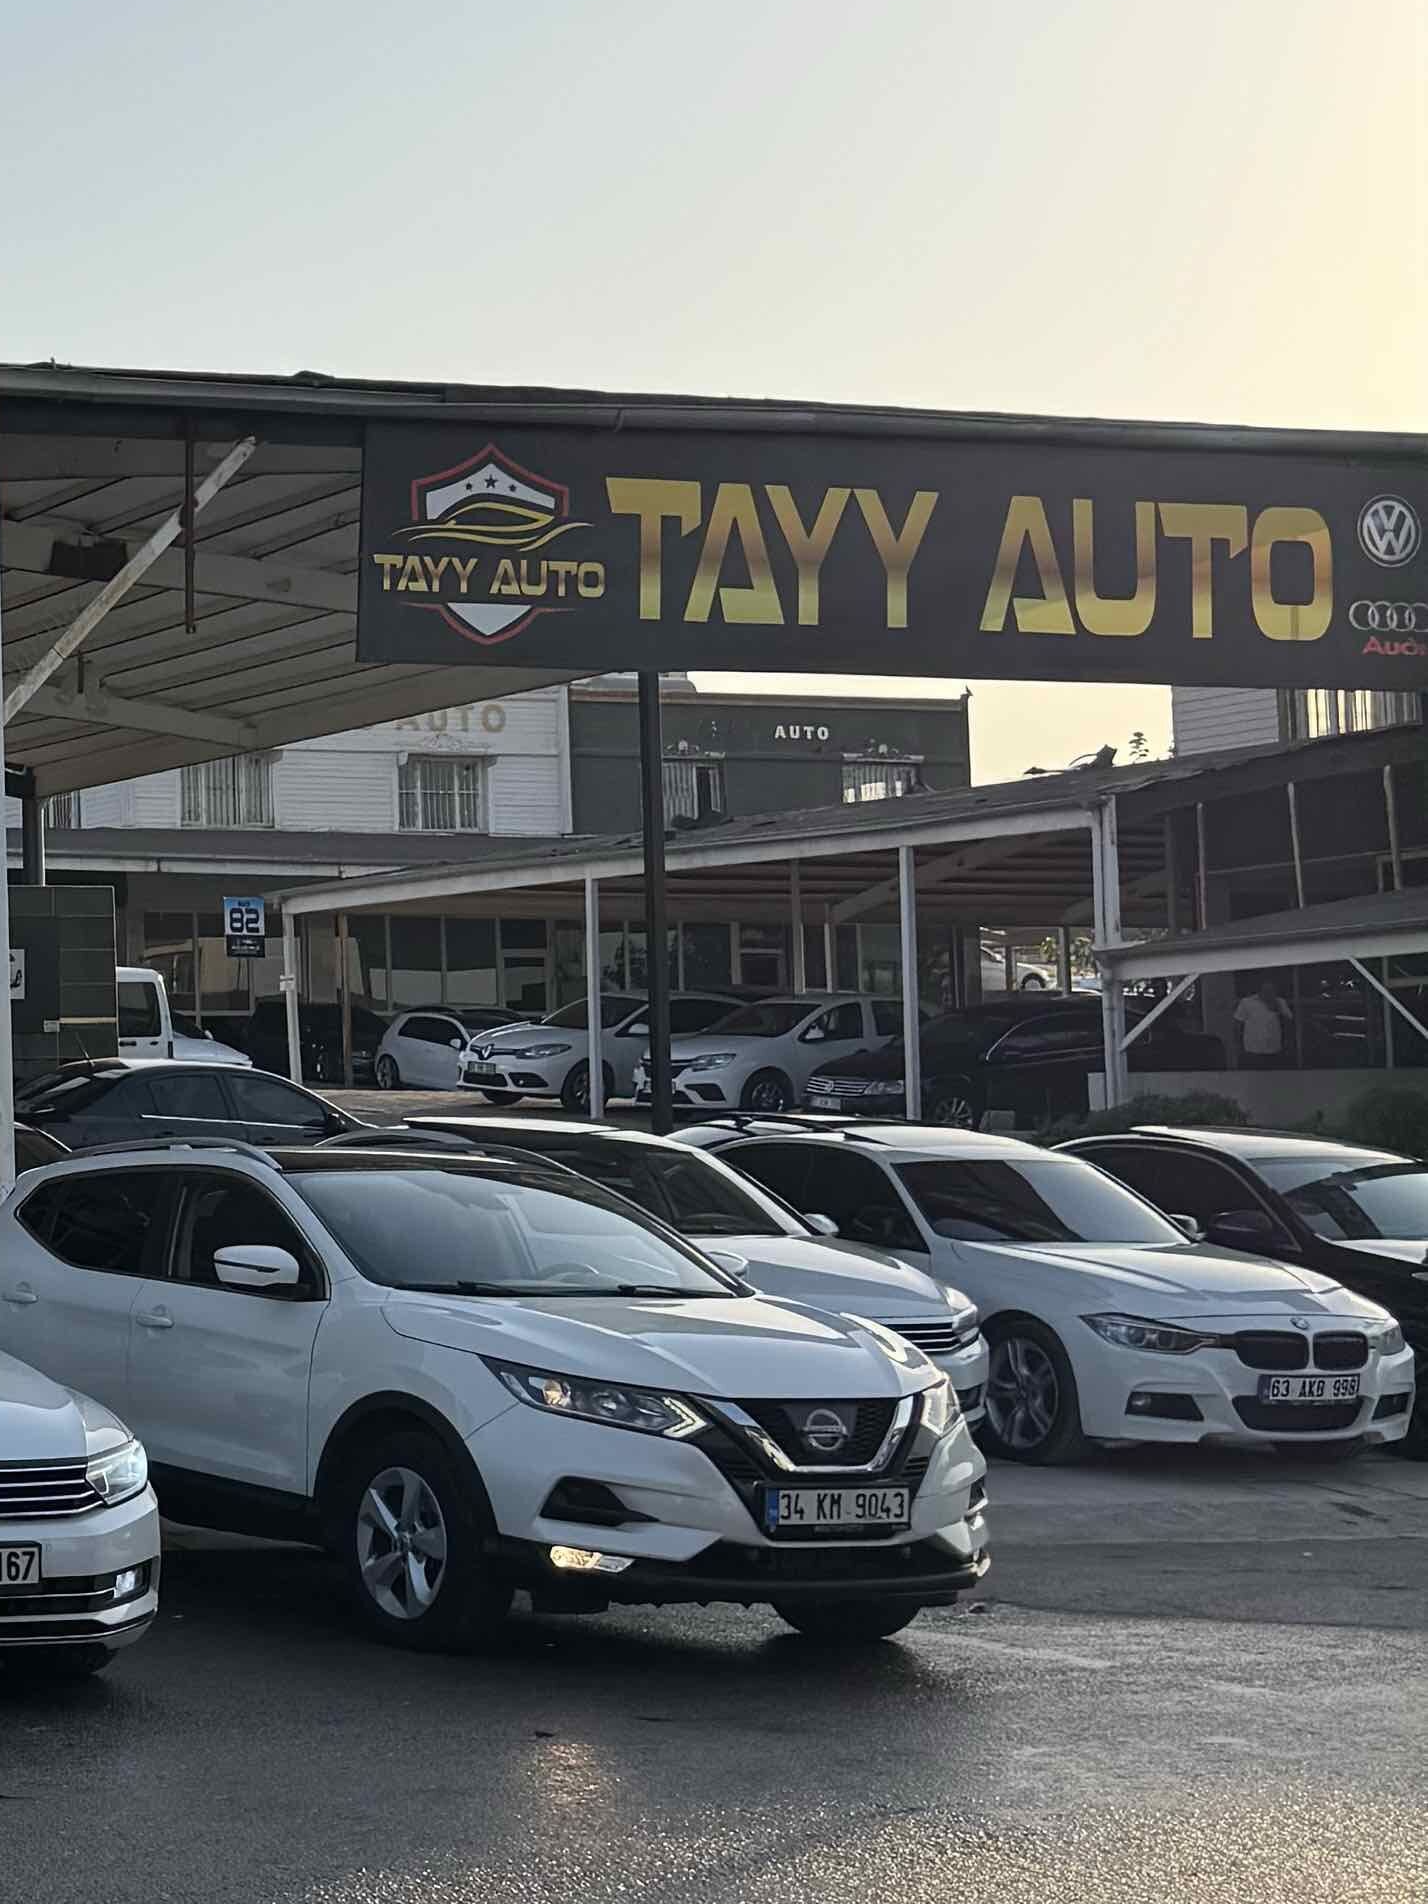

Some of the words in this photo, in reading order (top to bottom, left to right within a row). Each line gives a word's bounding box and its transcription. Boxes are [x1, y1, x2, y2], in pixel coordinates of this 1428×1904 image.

[606, 476, 939, 629] TAYY
[979, 495, 1334, 642] AUTO
[373, 554, 479, 594] TAYY
[488, 558, 606, 598] AUTO
[774, 725, 830, 741] AUTO
[229, 907, 260, 934] 82
[780, 1494, 805, 1520] 34
[816, 1493, 843, 1520] KM
[855, 1492, 905, 1519] 9043
